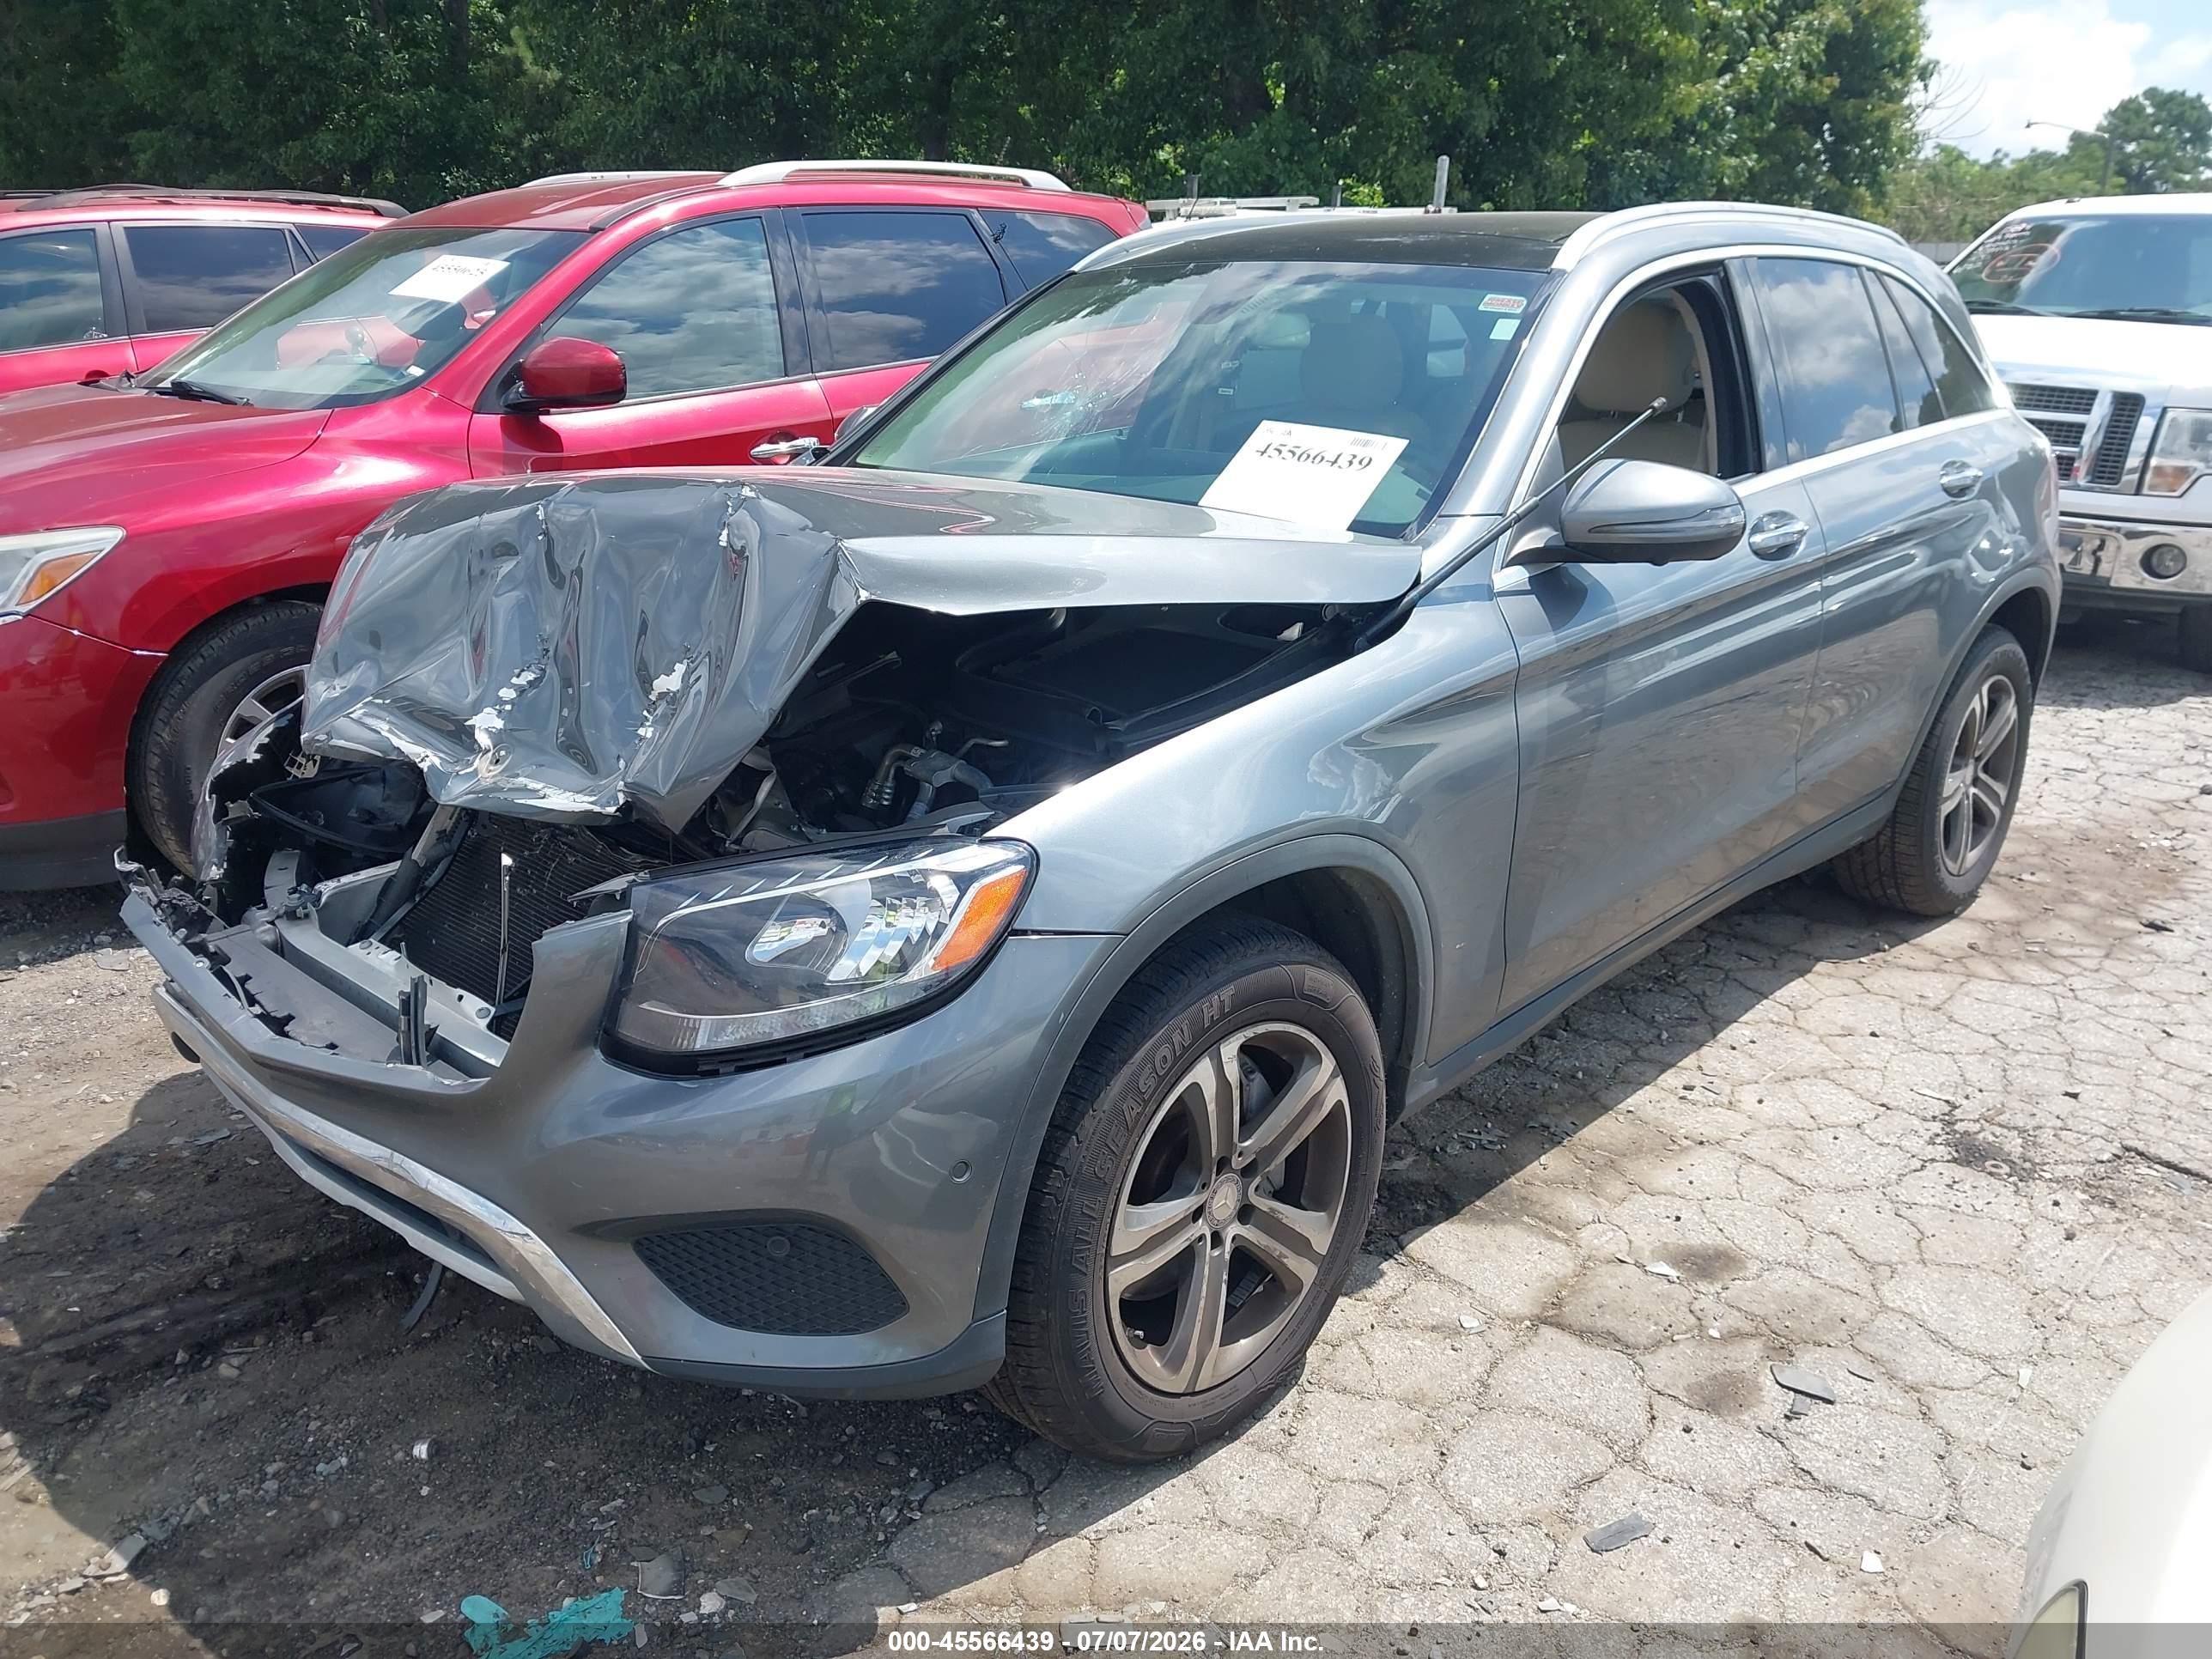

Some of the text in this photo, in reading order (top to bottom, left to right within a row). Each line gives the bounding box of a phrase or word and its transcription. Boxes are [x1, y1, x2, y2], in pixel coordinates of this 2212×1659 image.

[1255, 441, 1373, 471] 45566439
[1068, 987, 1236, 1400] MAVIS ALL SEASON HT
